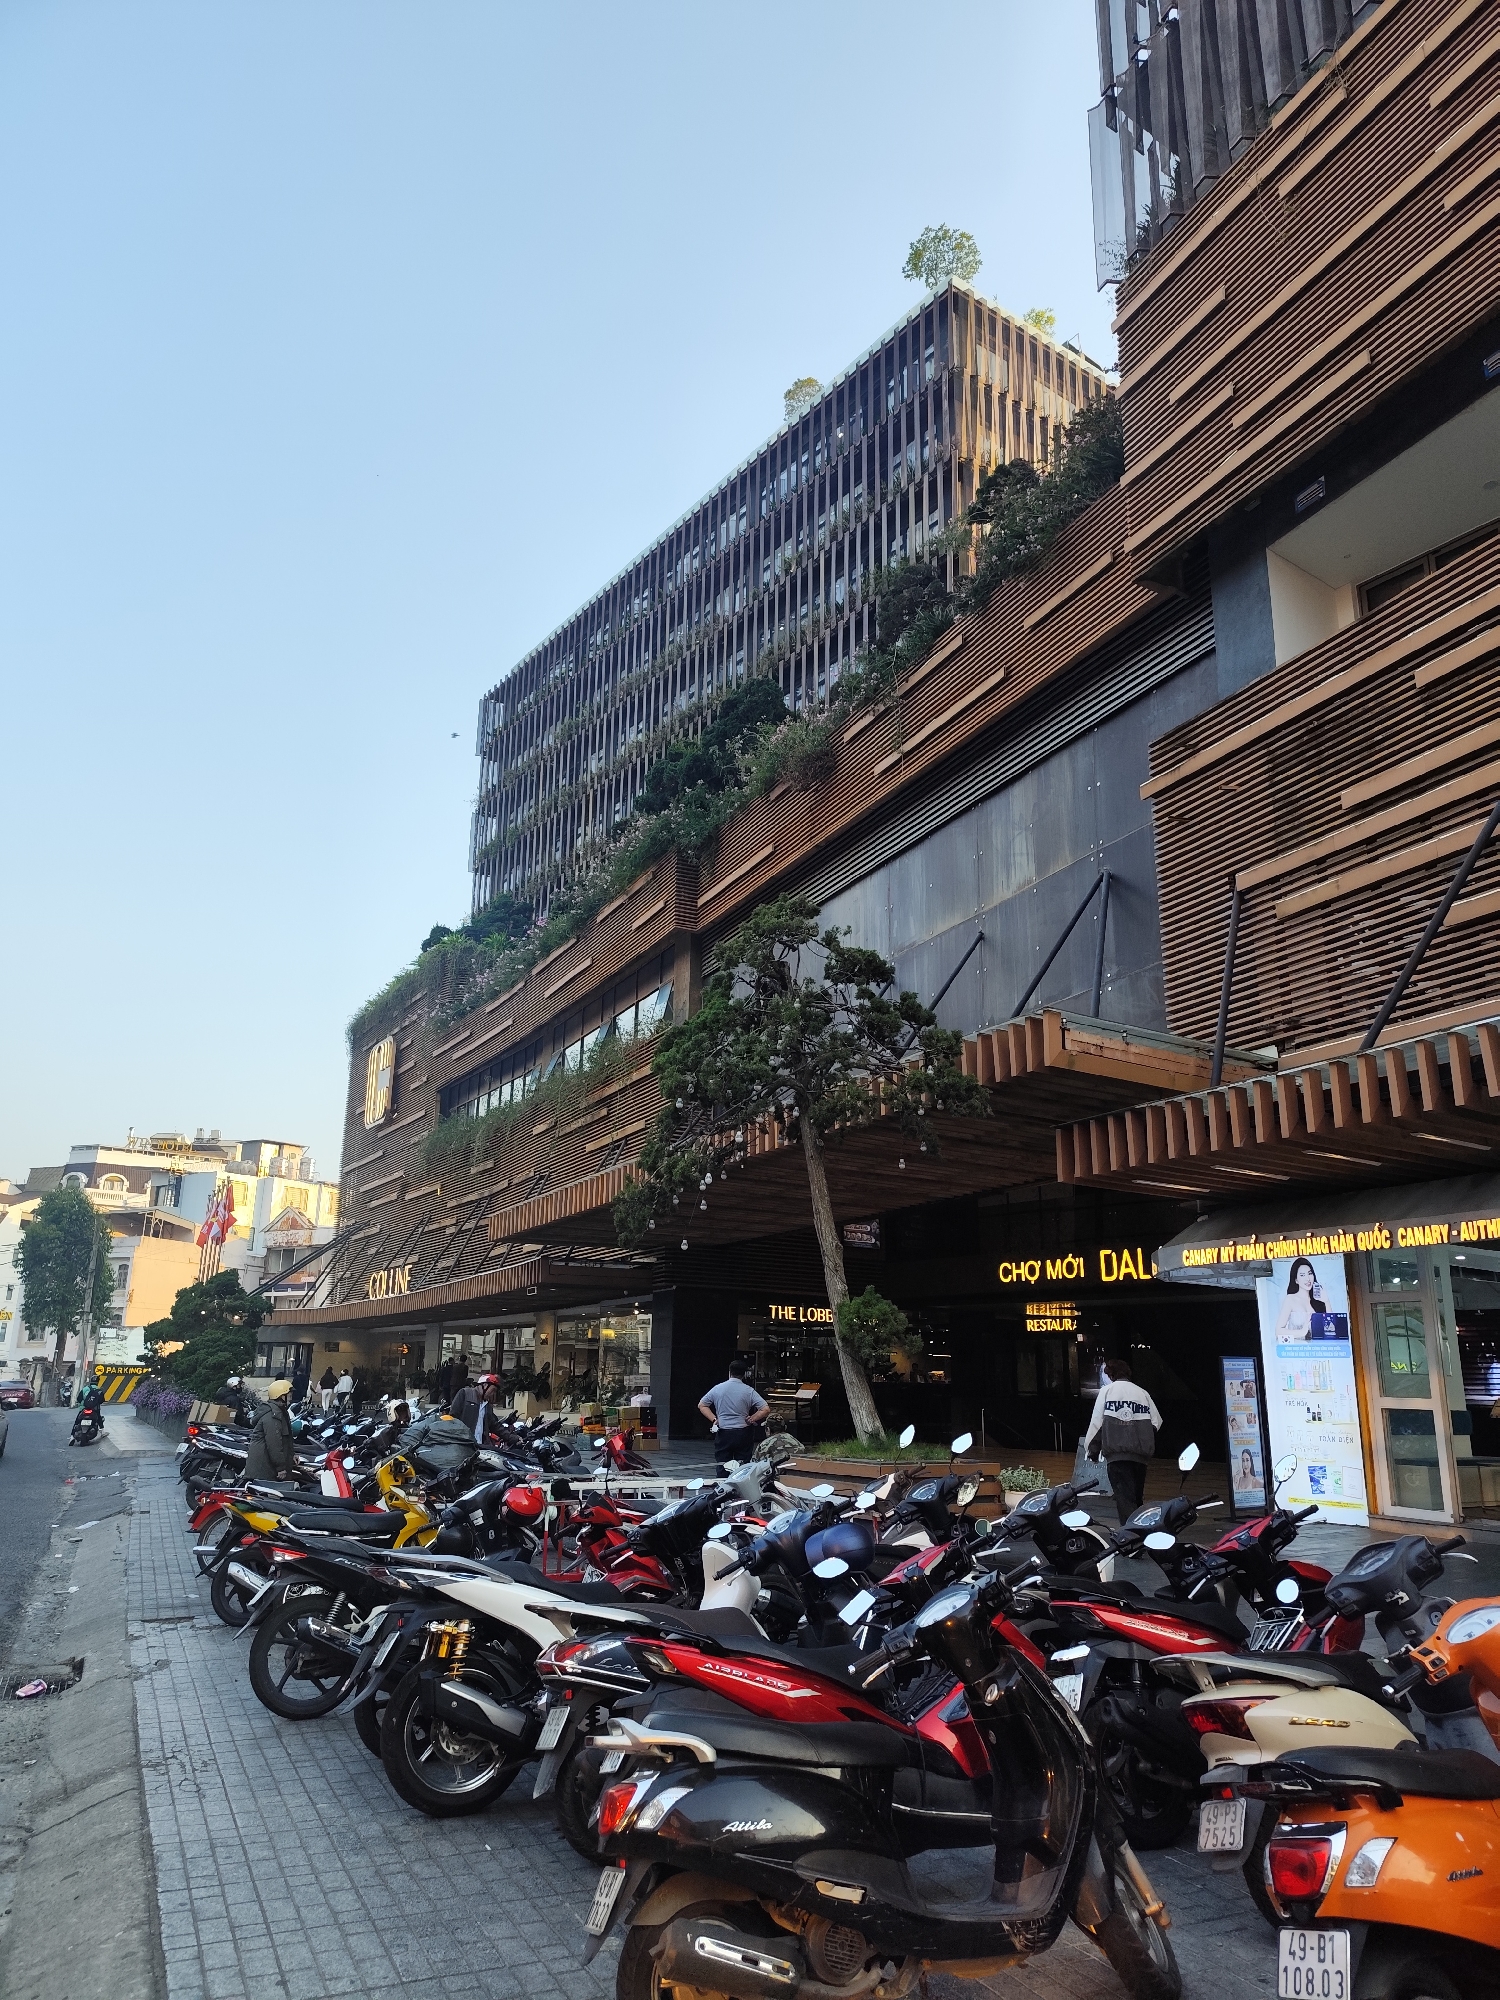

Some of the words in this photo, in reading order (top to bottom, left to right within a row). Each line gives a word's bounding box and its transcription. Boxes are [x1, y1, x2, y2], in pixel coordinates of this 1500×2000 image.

[1182, 1247, 1219, 1267] CANARY
[1236, 1233, 1265, 1261] PHẨM
[1266, 1235, 1298, 1259] CHÍNH
[1330, 1228, 1355, 1253] HÀN
[1357, 1222, 1391, 1252] QUỐC
[1397, 1223, 1449, 1248] CANARY
[999, 1260, 1042, 1284] CHỢ
[1046, 1253, 1085, 1280] MỚI
[1100, 1247, 1157, 1282] DAL
[369, 1265, 413, 1300] COLLINE
[769, 1304, 796, 1321] THE
[799, 1306, 834, 1323] LOBB
[105, 1366, 143, 1374] PARKING
[721, 1818, 774, 1833] Attila
[1205, 1803, 1237, 1826] 49-P3
[1204, 1826, 1237, 1849] 7525
[1288, 1931, 1335, 1965] 49-B1
[1283, 1965, 1344, 1999] 108.03
